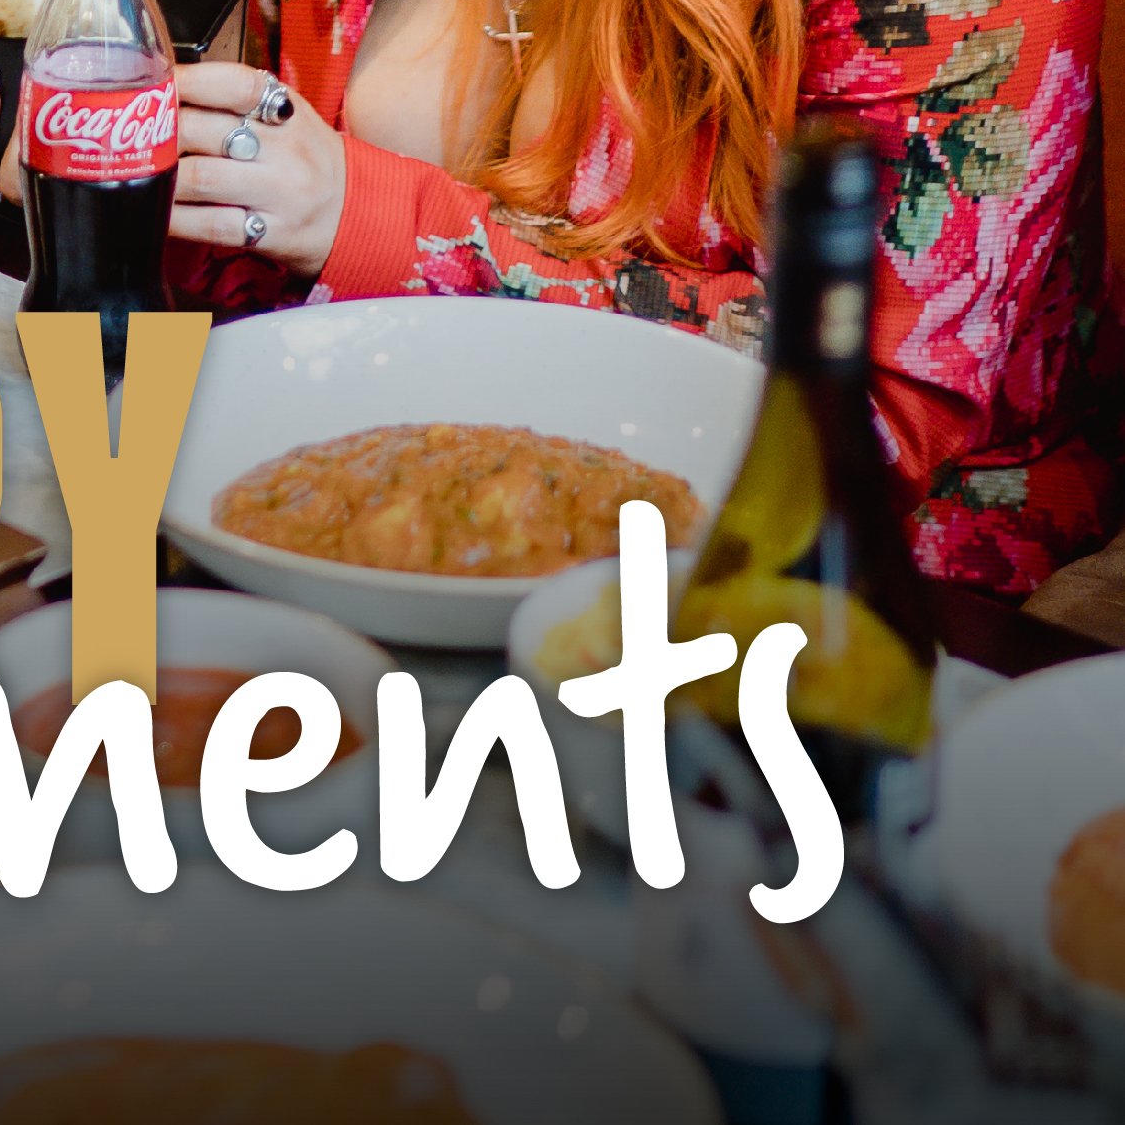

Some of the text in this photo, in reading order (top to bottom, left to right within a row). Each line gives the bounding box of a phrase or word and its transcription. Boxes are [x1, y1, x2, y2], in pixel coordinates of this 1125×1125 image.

[35, 82, 174, 151] Coca-Cola
[70, 149, 153, 162] ORIGINAL TASTE
